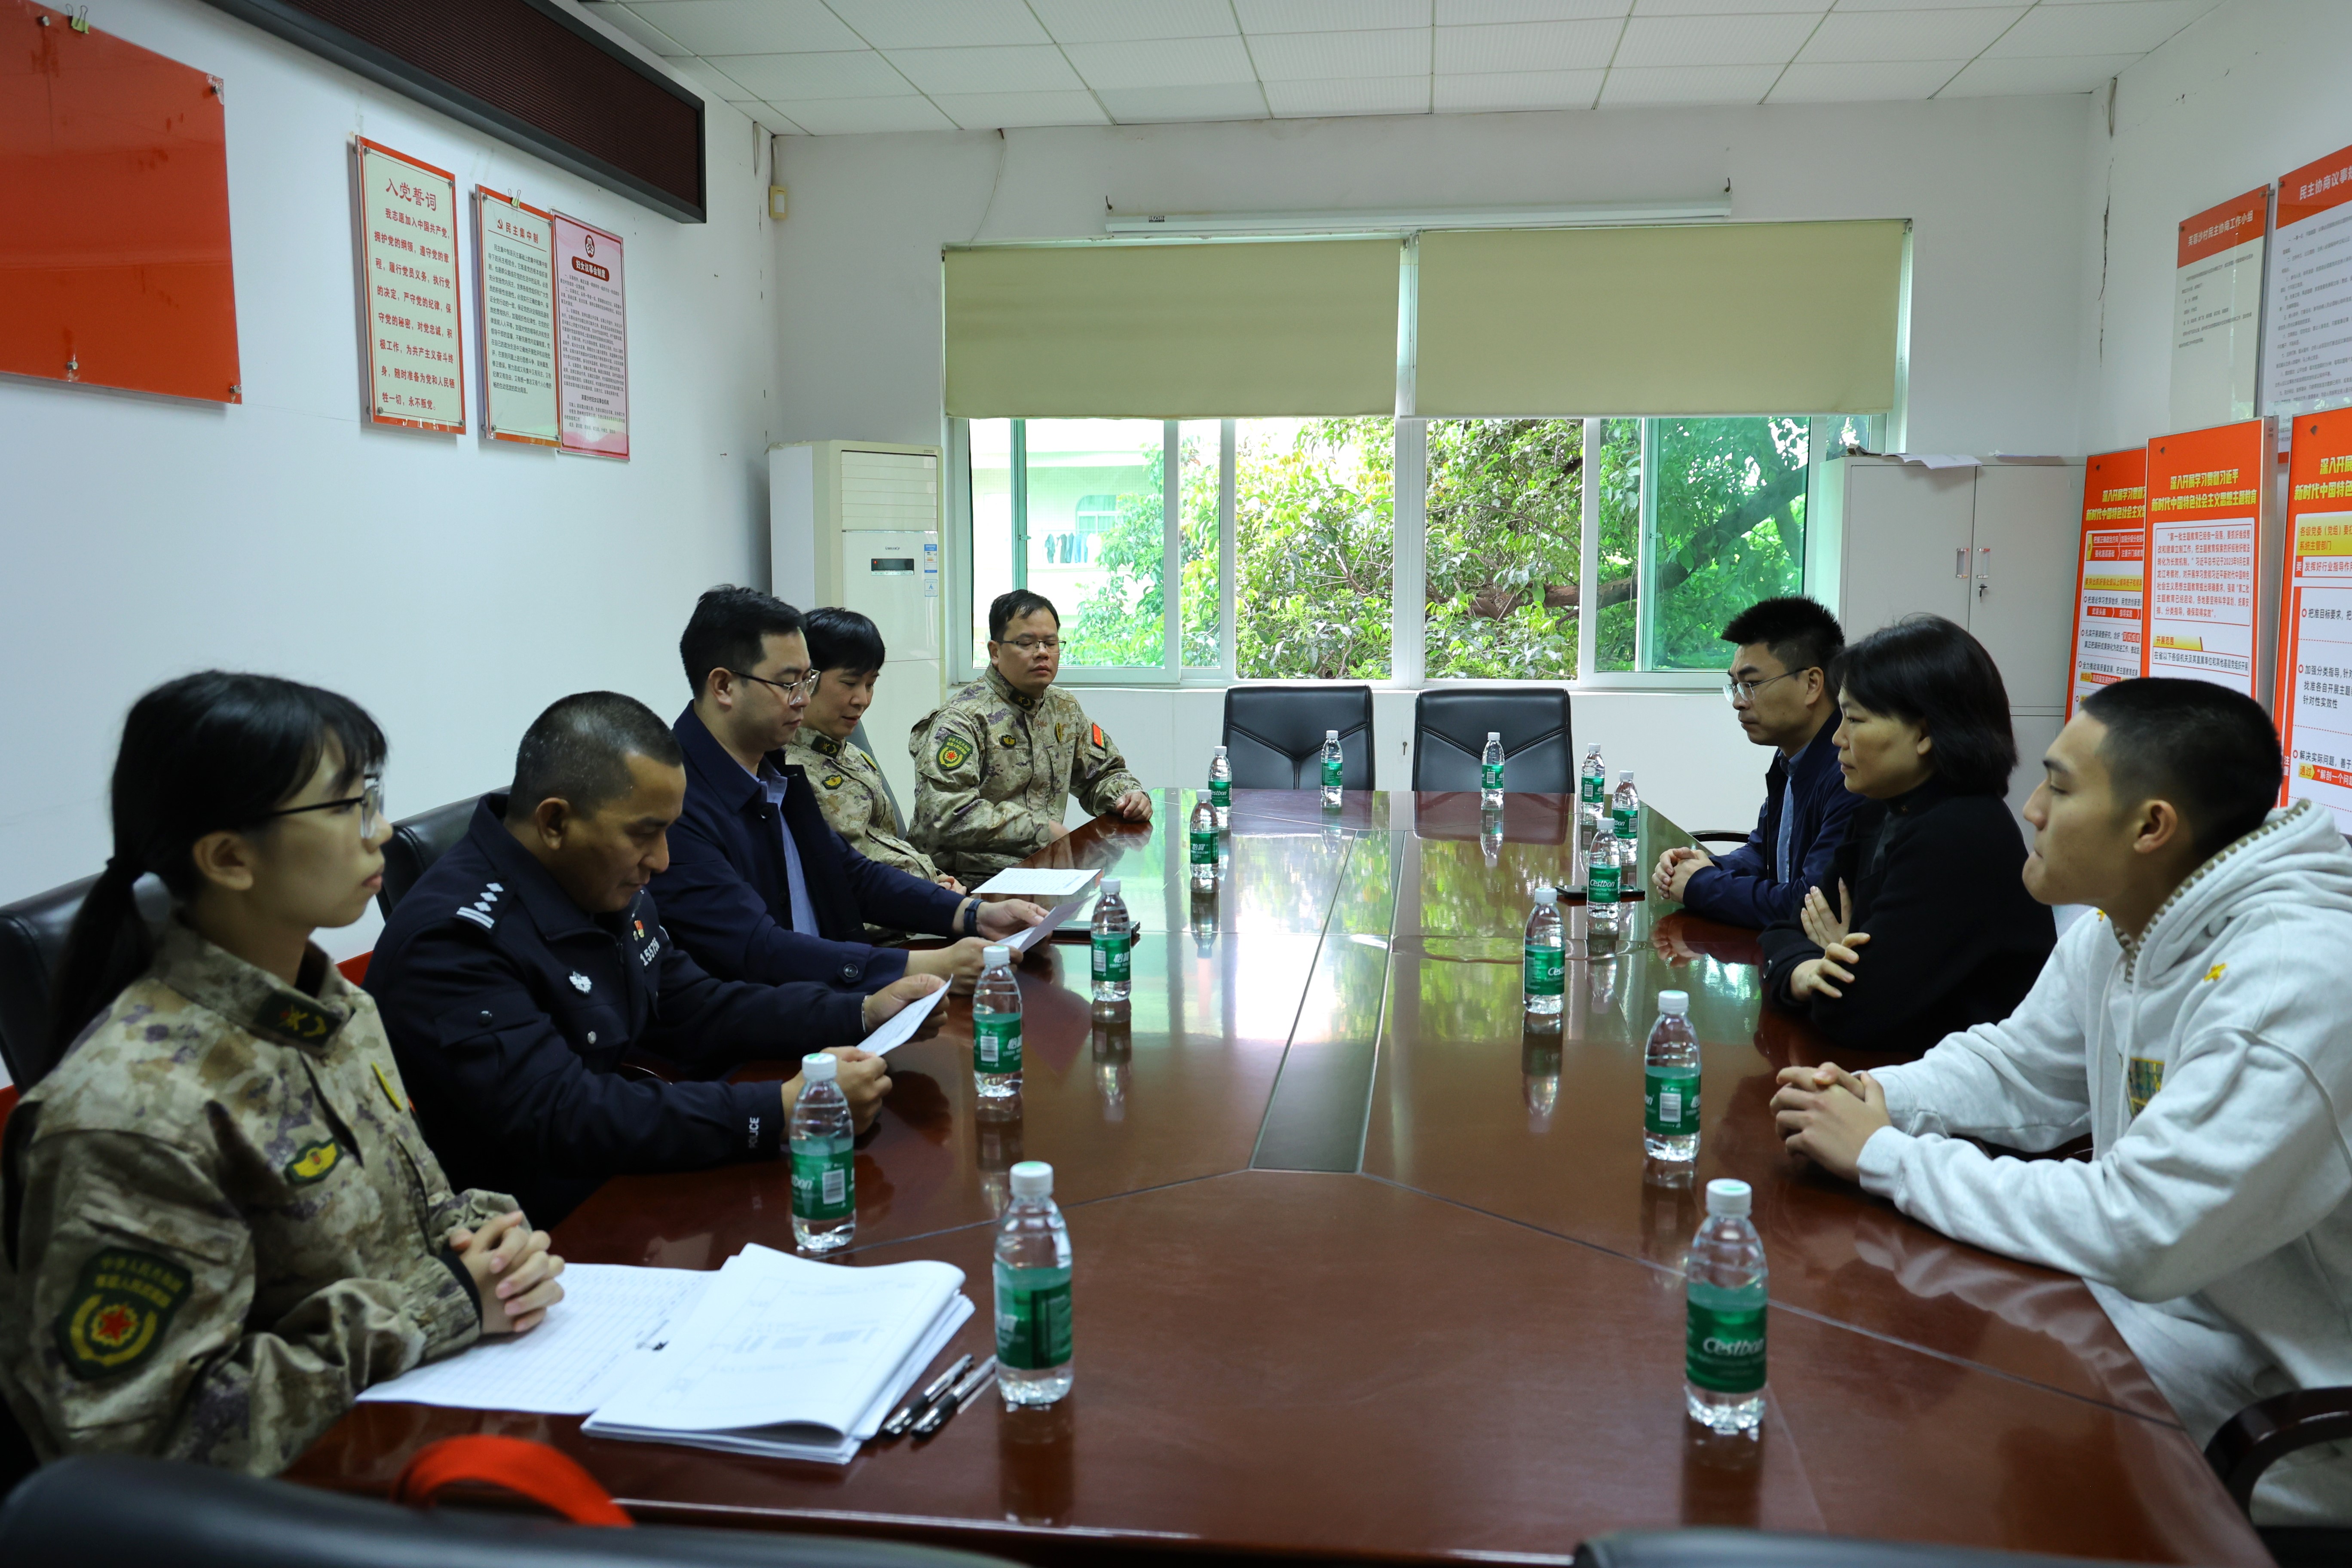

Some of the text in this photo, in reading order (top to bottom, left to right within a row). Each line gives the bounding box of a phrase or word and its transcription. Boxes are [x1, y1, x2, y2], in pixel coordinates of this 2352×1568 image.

[386, 178, 437, 211] 入党誓词
[506, 222, 538, 244] 民主集中制
[374, 230, 449, 263] 拥护党的纲领，遵守党的章
[375, 257, 450, 289] 程，履行党员义务，执行党
[576, 259, 606, 279] 妇女议事会制度
[377, 285, 452, 313] 的决定，严守党的纪律，保
[378, 312, 453, 339] 守党的秘密，对党忠诚，积
[380, 338, 453, 364] 极工作，为共产主义奋斗终
[381, 365, 455, 389] 身，随时准备为党和人民牺
[382, 392, 436, 411] 牲一切，永不叛党。
[2319, 455, 2352, 475] 深入开展
[2170, 469, 2239, 490] 深入开展学习贯彻习近平
[2151, 489, 2257, 511] 新时代中国特色社会主义思想主题教育
[2294, 480, 2352, 501] 新时代中国特色
[2299, 541, 2331, 551] 系统主管部门
[2296, 561, 2302, 572] 要
[2156, 636, 2174, 645] 开展范围
[2304, 680, 2352, 697] 找准各自开展主题
[2303, 695, 2337, 709] 针对性实效性
[2283, 755, 2290, 776] 注重
[2299, 750, 2352, 770] 解决实际问题，善于
